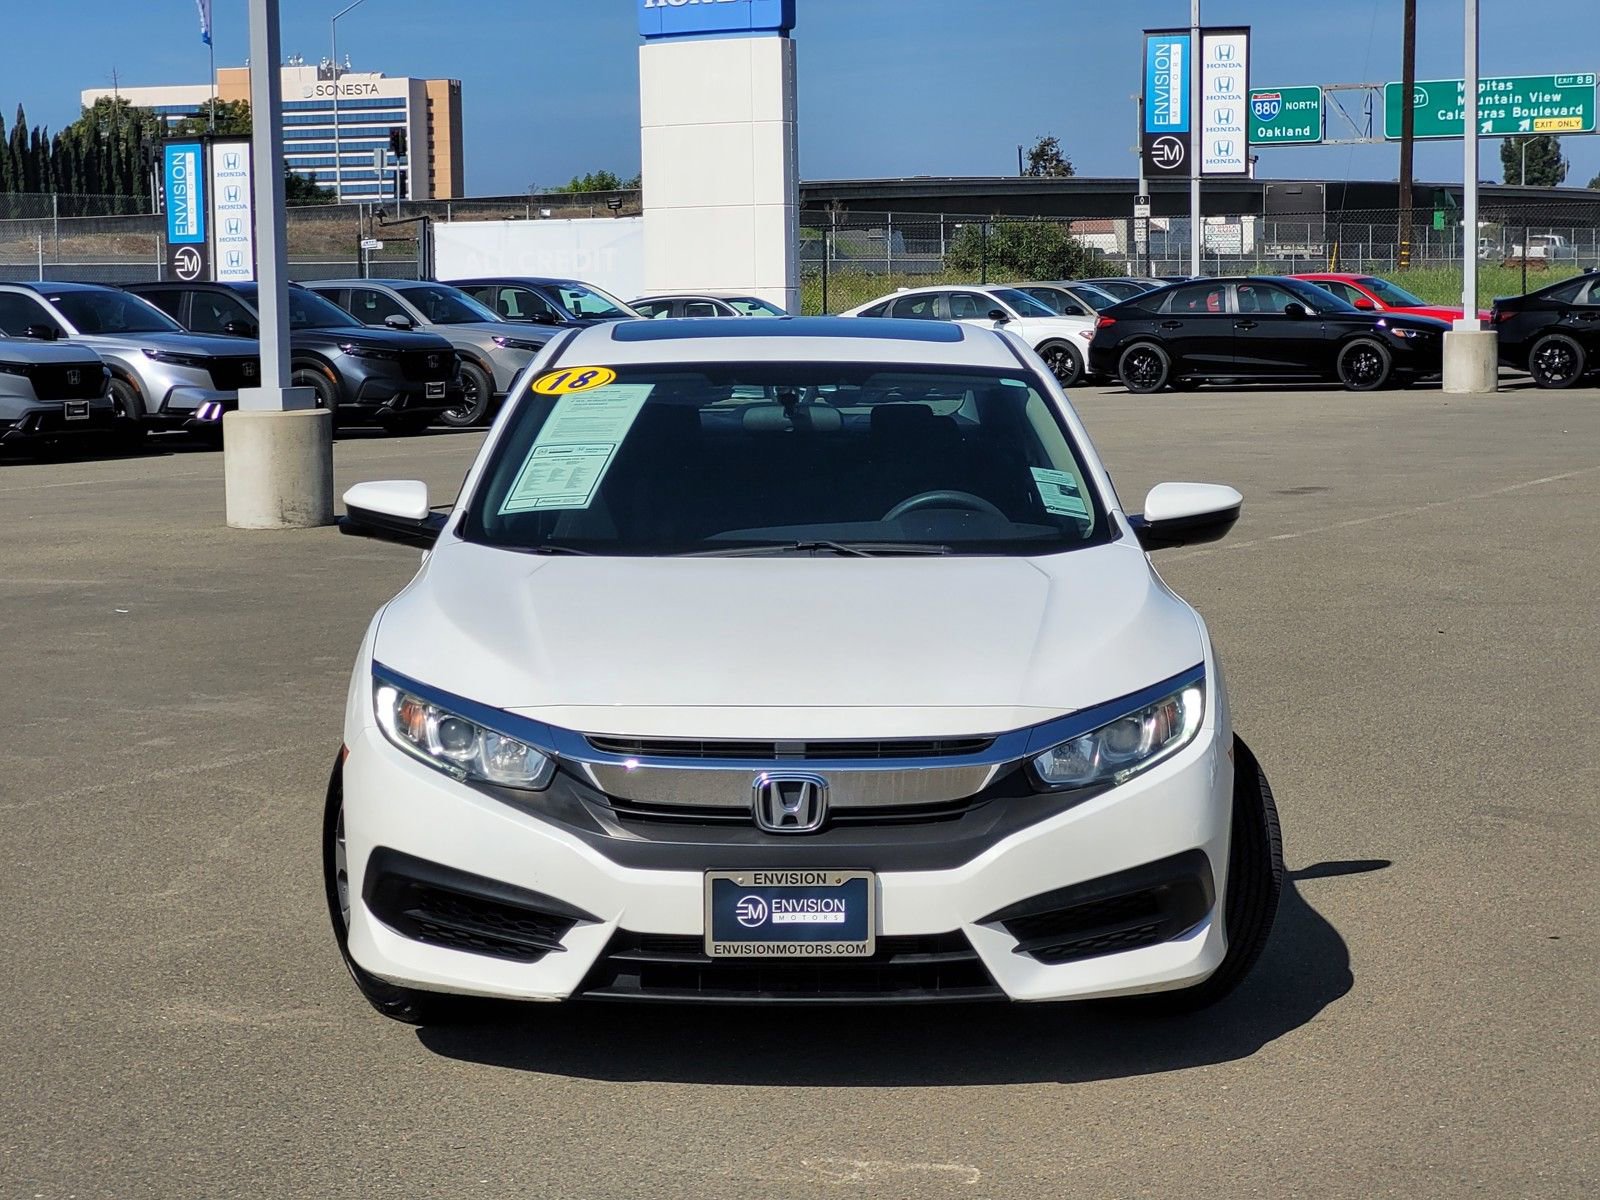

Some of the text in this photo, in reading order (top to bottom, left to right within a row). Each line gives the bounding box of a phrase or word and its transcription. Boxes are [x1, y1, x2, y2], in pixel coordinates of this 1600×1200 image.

[316, 84, 379, 96] SONESTA
[1154, 44, 1170, 125] ENVISION
[1457, 80, 1513, 94] Mpitas
[1413, 94, 1425, 104] 37
[1457, 91, 1562, 106] Muntain View
[1255, 101, 1318, 115] 880 NORTH
[1437, 104, 1583, 121] Calaeras Boulevard
[1257, 125, 1310, 138] Oakland
[172, 152, 188, 236] ENVISION
[518, 246, 618, 273] CREDIT
[547, 370, 599, 391] 18
[754, 873, 827, 884] ENVISION
[772, 899, 845, 912] ENVISION
[714, 944, 867, 955] ENVISIONMOTORS.COM
